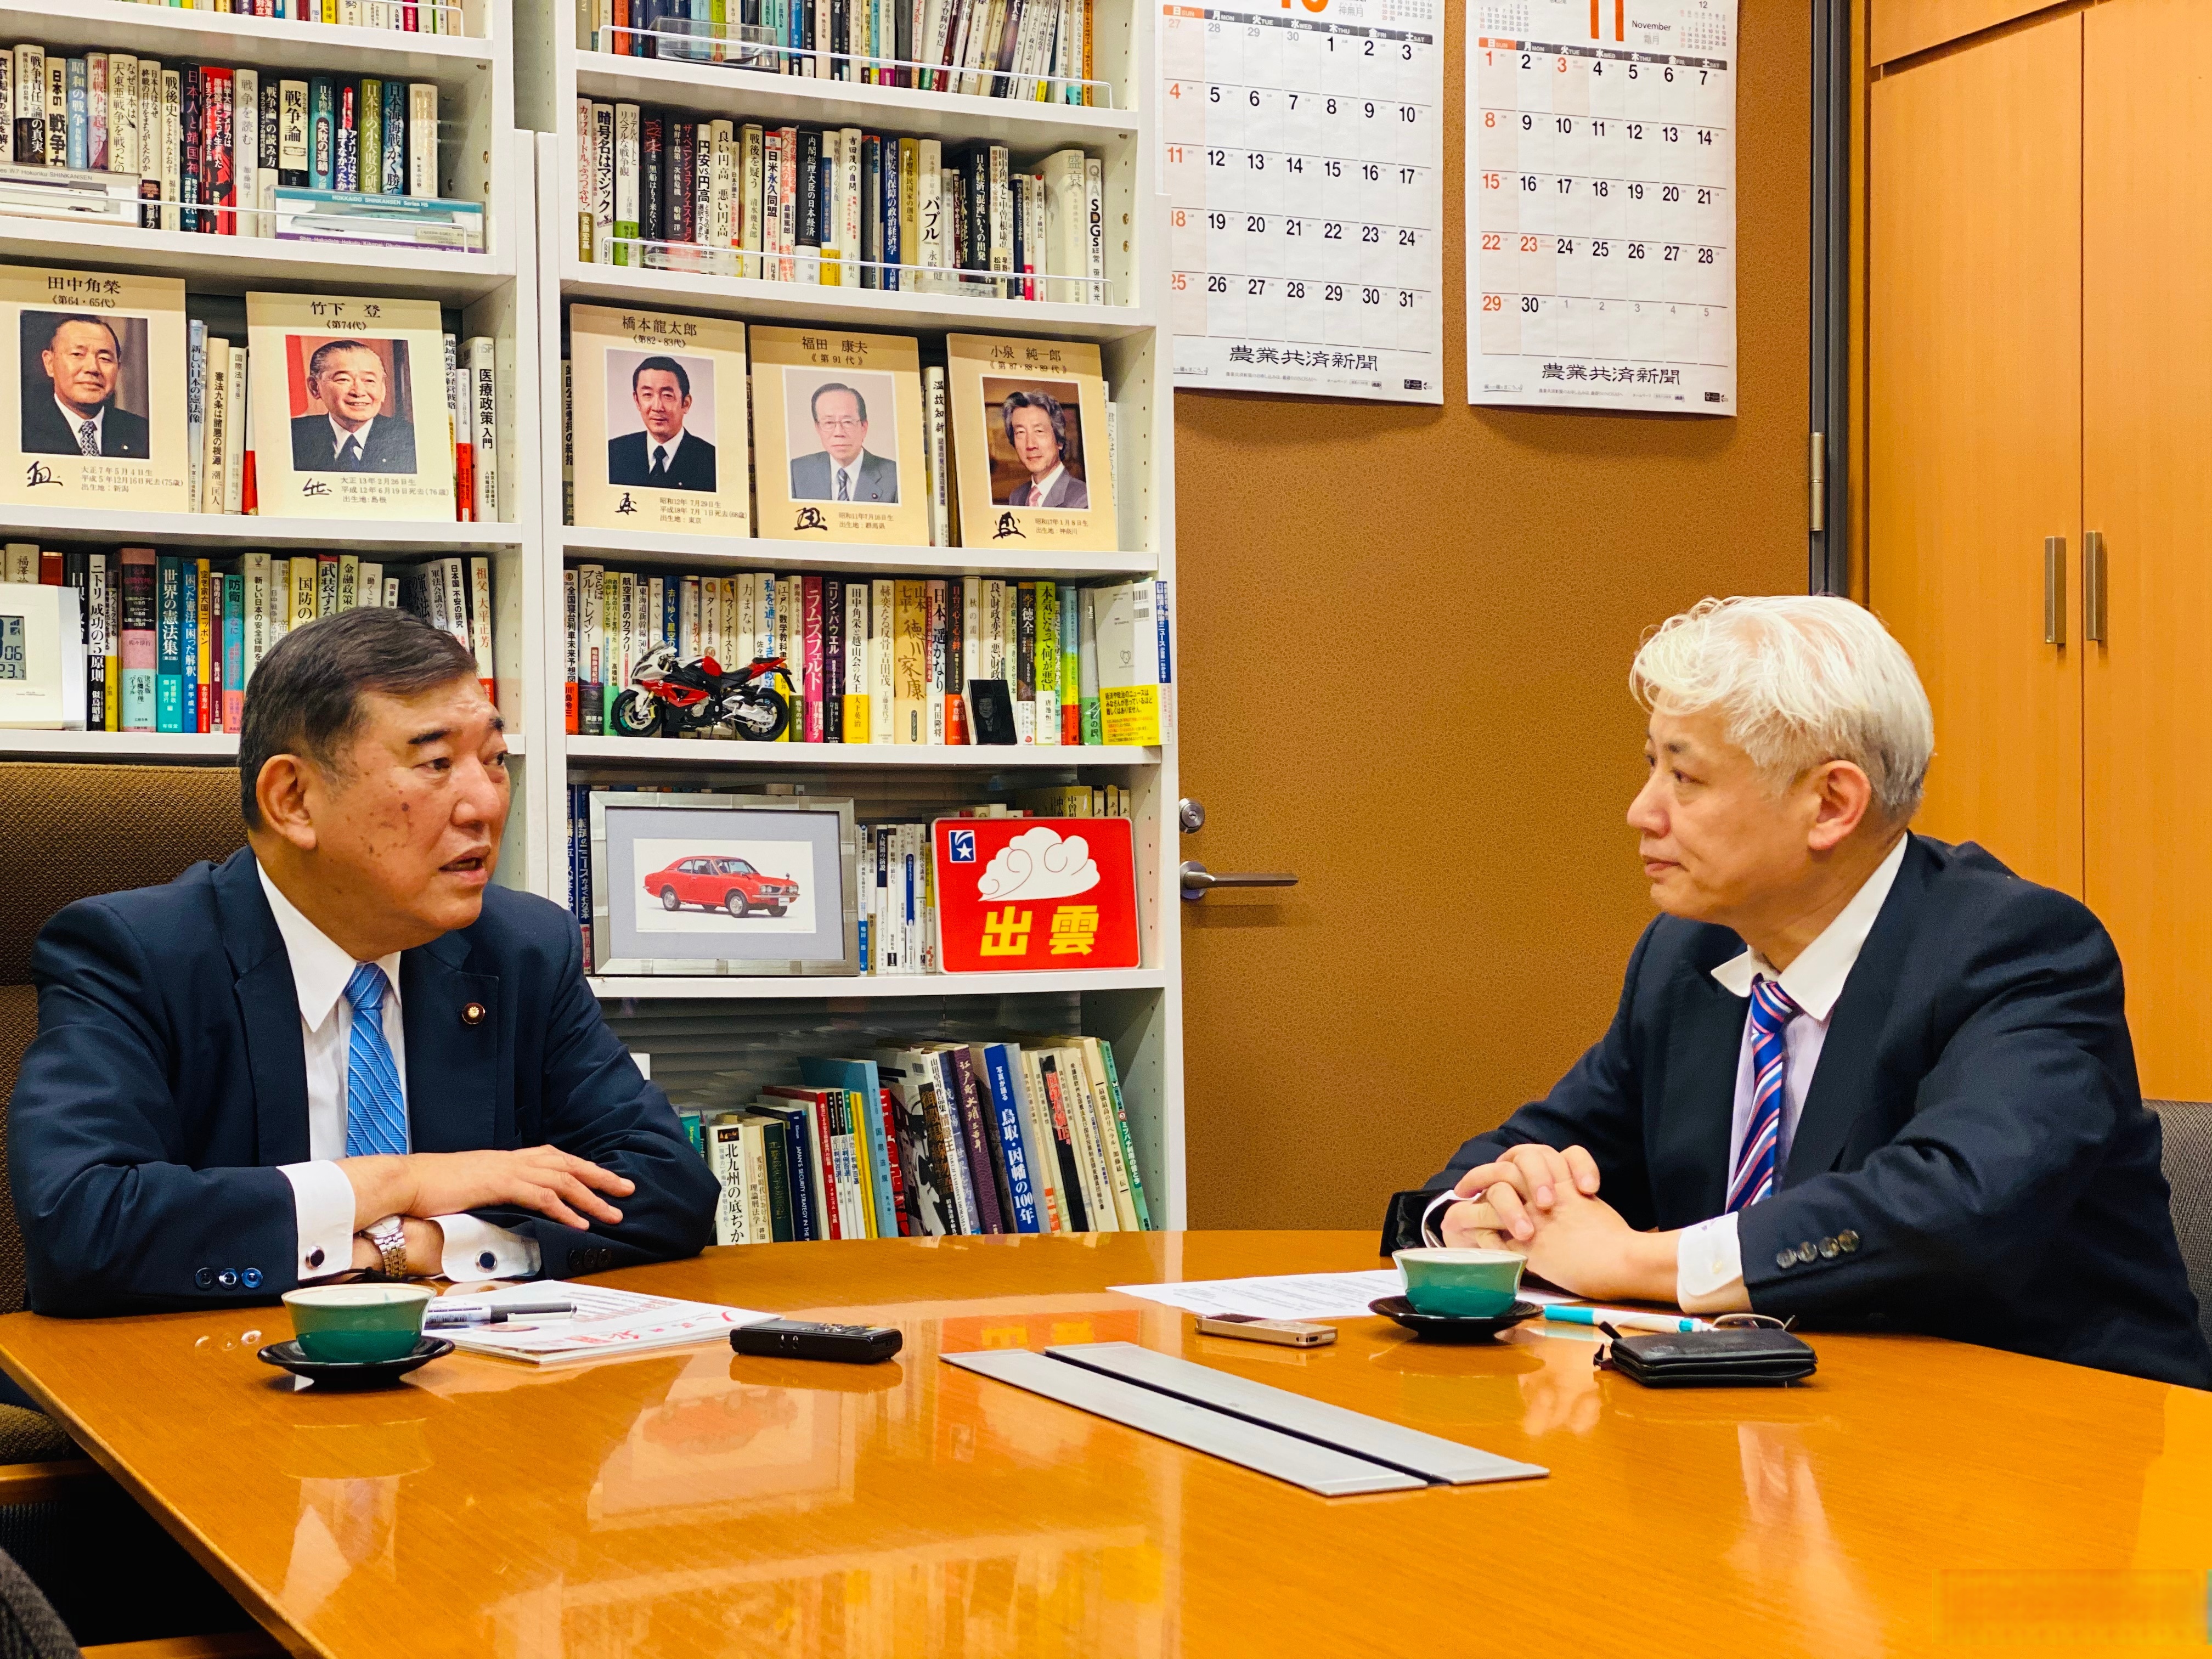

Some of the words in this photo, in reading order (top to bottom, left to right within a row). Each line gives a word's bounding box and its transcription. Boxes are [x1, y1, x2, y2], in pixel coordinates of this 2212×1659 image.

[1632, 20, 1671, 31] November
[72, 61, 84, 126] 昭和の戦争
[127, 63, 136, 119] なぜ日本は
[1485, 50, 1492, 66] 1
[1521, 53, 1531, 70] 2
[1557, 57, 1567, 73] 3
[1593, 61, 1602, 76] 4
[1628, 64, 1638, 80] 5
[1664, 66, 1674, 83] 6
[1699, 70, 1708, 86] 7
[31, 52, 43, 153] 「戦争責任」論の真実
[142, 69, 150, 171] 終戦の日付をまちがえたのか
[165, 76, 178, 174] 戦後史をよみなおす
[241, 80, 253, 145] 戦争を読む
[284, 89, 302, 143] 戦争論
[1169, 83, 1181, 99] 4
[1210, 86, 1221, 103] 5
[1249, 90, 1260, 107] 6
[1289, 94, 1299, 110] 7
[1327, 98, 1337, 115] 8
[1364, 102, 1375, 119] 9
[1399, 106, 1415, 123] 10
[338, 129, 347, 190] 勝てなかったか
[348, 130, 357, 190] アメリカはなぜ
[597, 110, 612, 213] 暗号名はマジック
[619, 111, 629, 176] リベラルな戦争観
[718, 131, 729, 180] 良い円高
[749, 133, 760, 188] 戦後を疑う
[849, 136, 857, 191] 吉田茂の自問
[49, 172, 92, 180] SHINKANSEN
[243, 167, 251, 198] 加藤陽子
[767, 151, 778, 217] 日米永久同盟
[806, 136, 817, 236] 内閣総理大臣の日本経済
[1068, 154, 1082, 187] 盛衰
[365, 197, 401, 205] SHINKANSEN
[718, 189, 729, 237] 悪い円高
[887, 141, 896, 255] 国家安全保障の政治経済学
[922, 196, 940, 241] バブル
[976, 154, 986, 261] 日本経済「混沌」からの出発
[48, 276, 121, 295] 田中角榮
[311, 302, 346, 316] 竹下
[364, 304, 381, 318] 登
[1207, 275, 1227, 293] 26
[1248, 278, 1266, 295] 27
[1286, 281, 1305, 299] 28
[1325, 284, 1343, 302] 29
[1362, 287, 1380, 305] 30
[1399, 291, 1413, 308] 31
[1483, 295, 1502, 311] 29
[1521, 296, 1539, 313] 30
[622, 315, 697, 336] 橋本龍太郎
[802, 336, 827, 350] 福田
[842, 340, 868, 354] 康夫
[444, 338, 456, 410] 地域産業の経営戦略
[991, 346, 1015, 359] 小泉
[1026, 348, 1062, 362] 純一郎
[1229, 345, 1378, 371] 農業共済新聞
[1542, 362, 1680, 385] 農業共済新聞
[479, 369, 493, 449] 医療政策入門
[933, 380, 945, 433] 温故知新
[91, 565, 104, 600] ニトリ
[476, 567, 487, 592] 祖父
[899, 585, 913, 612] 七平
[915, 585, 927, 612] 山本
[934, 589, 946, 621] 日本
[162, 569, 178, 654] 世界の憲法集
[185, 574, 196, 677] 困った憲法・困った解釈
[200, 570, 210, 645] 空き家大国ニッポン
[476, 598, 490, 648] 大平正芳
[622, 577, 631, 652] 航空運賃のカラクリ
[725, 598, 733, 669] ウィーン・オーストリア
[742, 584, 754, 634] 力まない
[828, 581, 839, 654] コリン・パウエル
[990, 582, 1001, 640] 良い財政赤字
[1023, 594, 1034, 634] 李徳全
[805, 590, 822, 691] ラムズフェルド
[851, 588, 861, 693] 田中角栄と越山会の女王
[898, 619, 926, 701] 徳川家康
[933, 628, 946, 693] 遥かなり
[1040, 585, 1053, 691] 本気になって何が悪い
[880, 652, 890, 686] 吉田茂
[934, 703, 942, 737] 門田隆将
[980, 905, 1099, 956] 出雲
[996, 1066, 1008, 1101] 写真が語る
[1001, 1108, 1034, 1224] 鳥取・因幡の100年
[725, 1143, 744, 1243] 北九州の底ぢか
[750, 1184, 760, 1224] 理論刑法学
